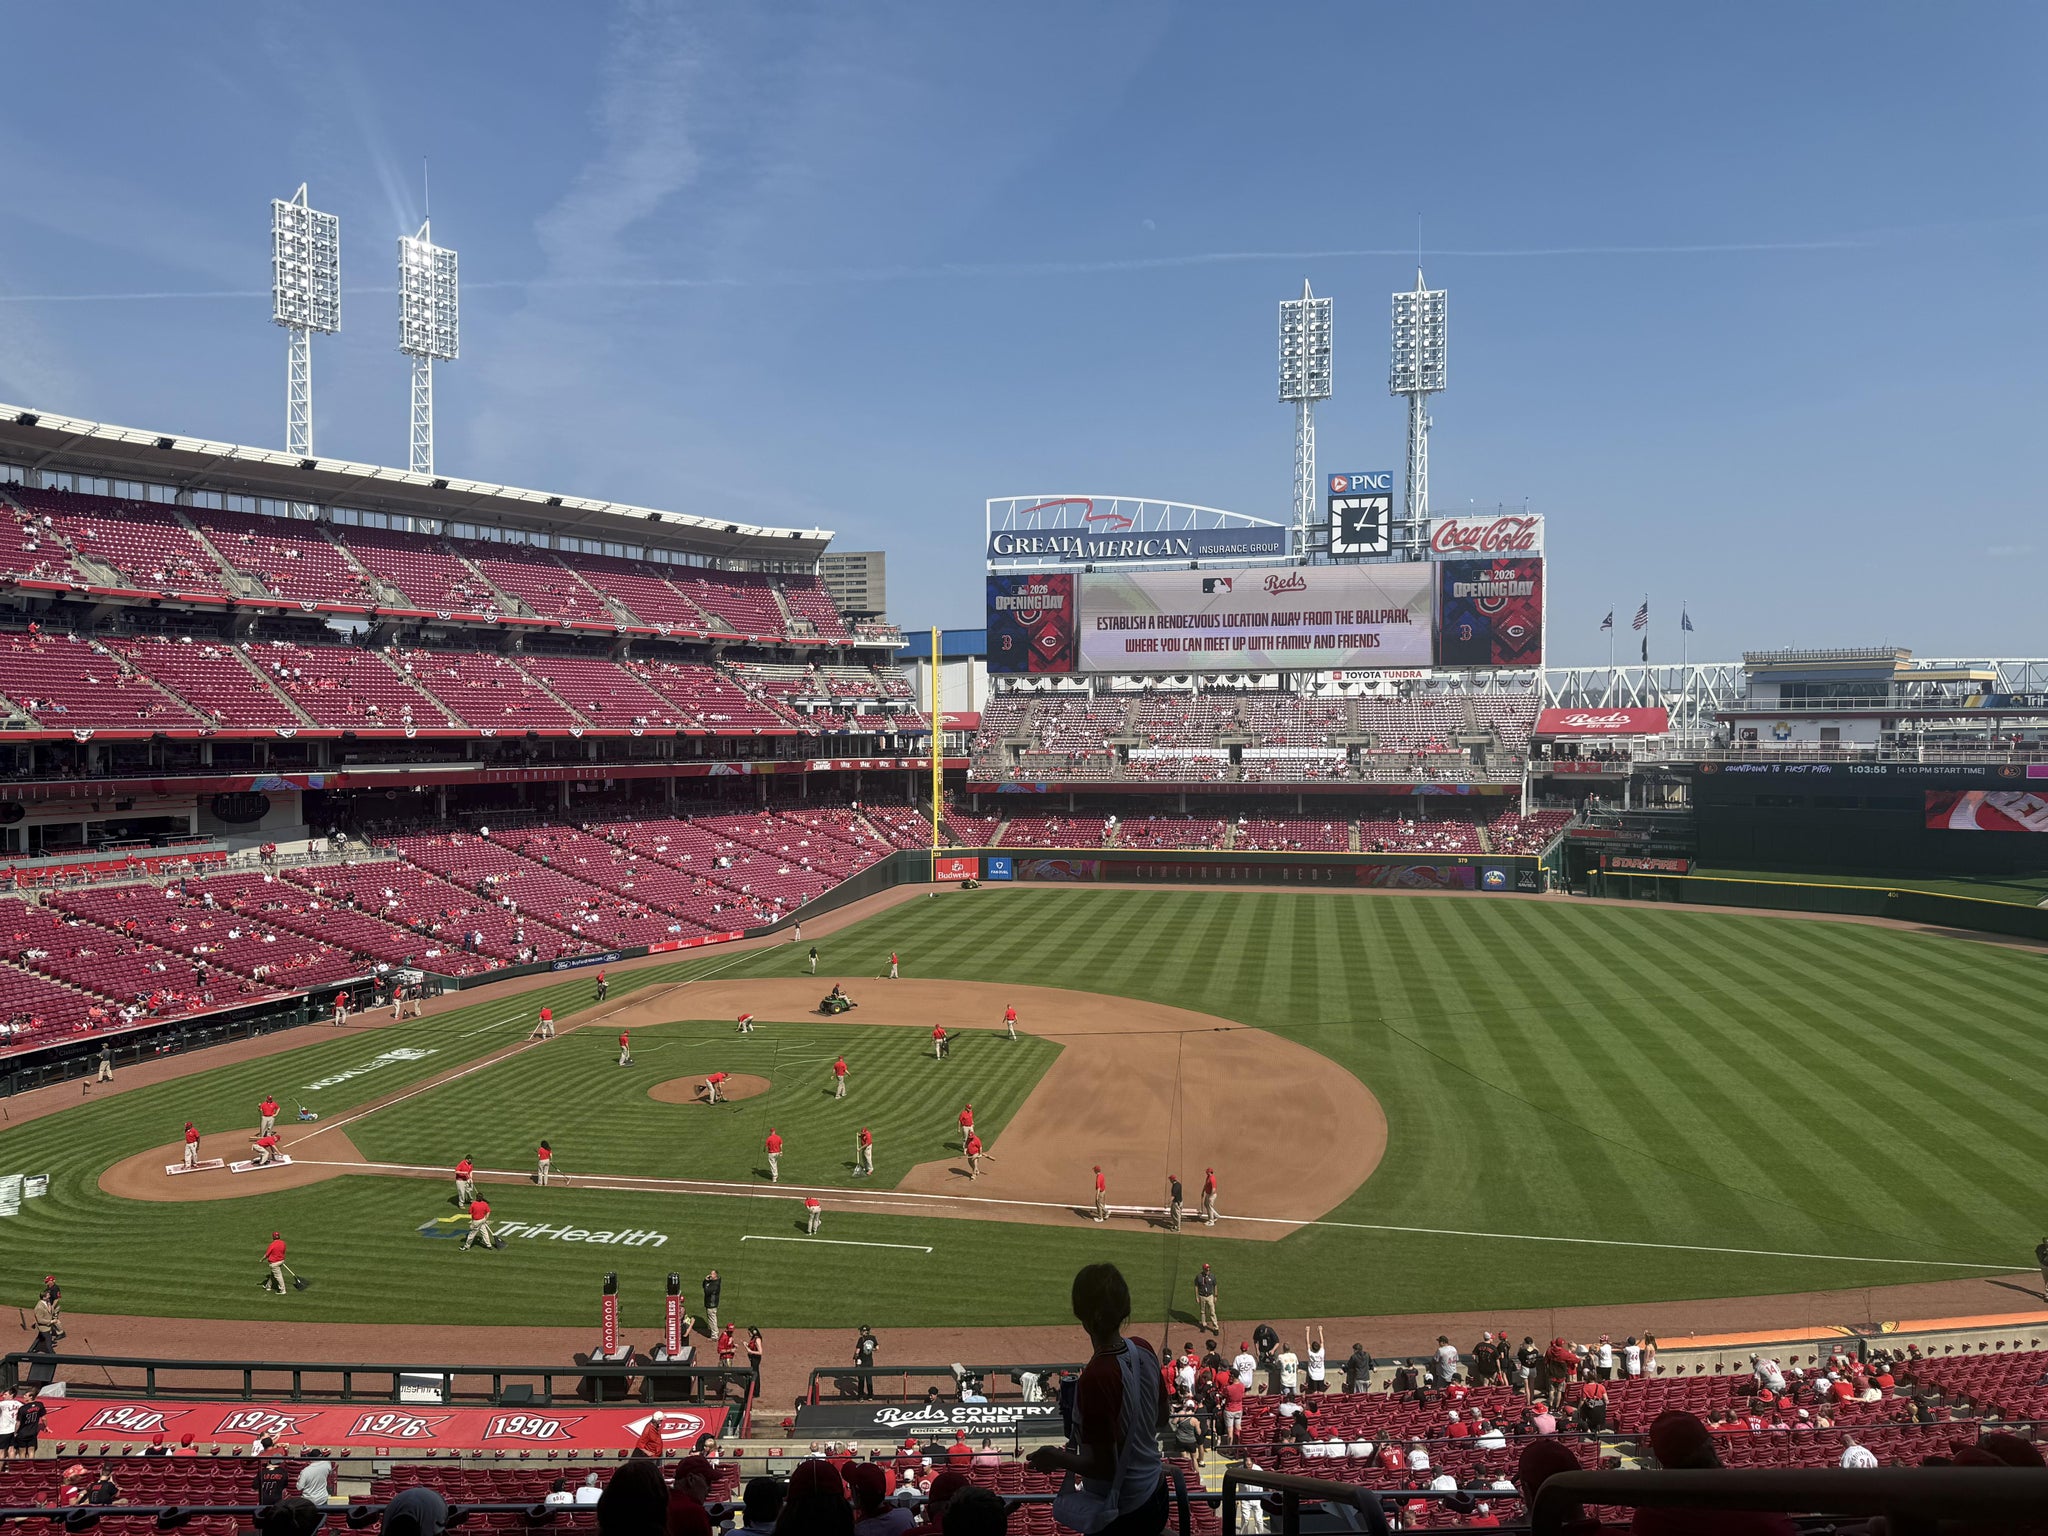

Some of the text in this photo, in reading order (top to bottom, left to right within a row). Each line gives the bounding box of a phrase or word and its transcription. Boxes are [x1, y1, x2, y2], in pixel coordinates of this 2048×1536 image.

[1350, 474, 1391, 490] PNC
[1432, 515, 1542, 553] Coca-Cola
[993, 533, 1193, 558] GREAT AMERICAN
[1199, 542, 1279, 554] INSURANCE GROUP
[1493, 570, 1516, 580] 2026
[1029, 584, 1049, 595] 2026
[1263, 571, 1307, 596] Reds
[1453, 580, 1535, 597] OPENING DAY
[995, 594, 1065, 611] OPENING DAY
[1096, 608, 1412, 631] ESTABLISH A RENDEZVOUS LOCATION AWAY FROM THE BALLPARK,
[1125, 633, 1381, 653] WHERE YOU CAN MEET UP WITH FAMILY AND FRIENDS
[1344, 670, 1423, 680] TOYOTA TUNDRA
[1560, 712, 1631, 726] Reds
[576, 768, 607, 779] REDS
[1725, 764, 1833, 773] COUNTDOWN TO FIRST PITCH
[1848, 765, 1888, 774] 1:03:55
[1918, 766, 1933, 774] PM
[1933, 766, 1961, 775] START
[1962, 767, 1985, 775] TIME]
[70, 783, 117, 798] REDS
[1282, 867, 1334, 881] REDS
[493, 1220, 669, 1248] TriHealth
[668, 1300, 677, 1351] CINCINNATI REDS
[1284, 1363, 1296, 1374] 41
[93, 1407, 165, 1432] 1940
[225, 1411, 296, 1435] 1975
[873, 1404, 1056, 1428] Reds COUNTRY
[358, 1413, 427, 1438] 1976
[493, 1415, 561, 1439] 1990
[660, 1421, 702, 1431] EDS
[1391, 1454, 1399, 1466] 4
